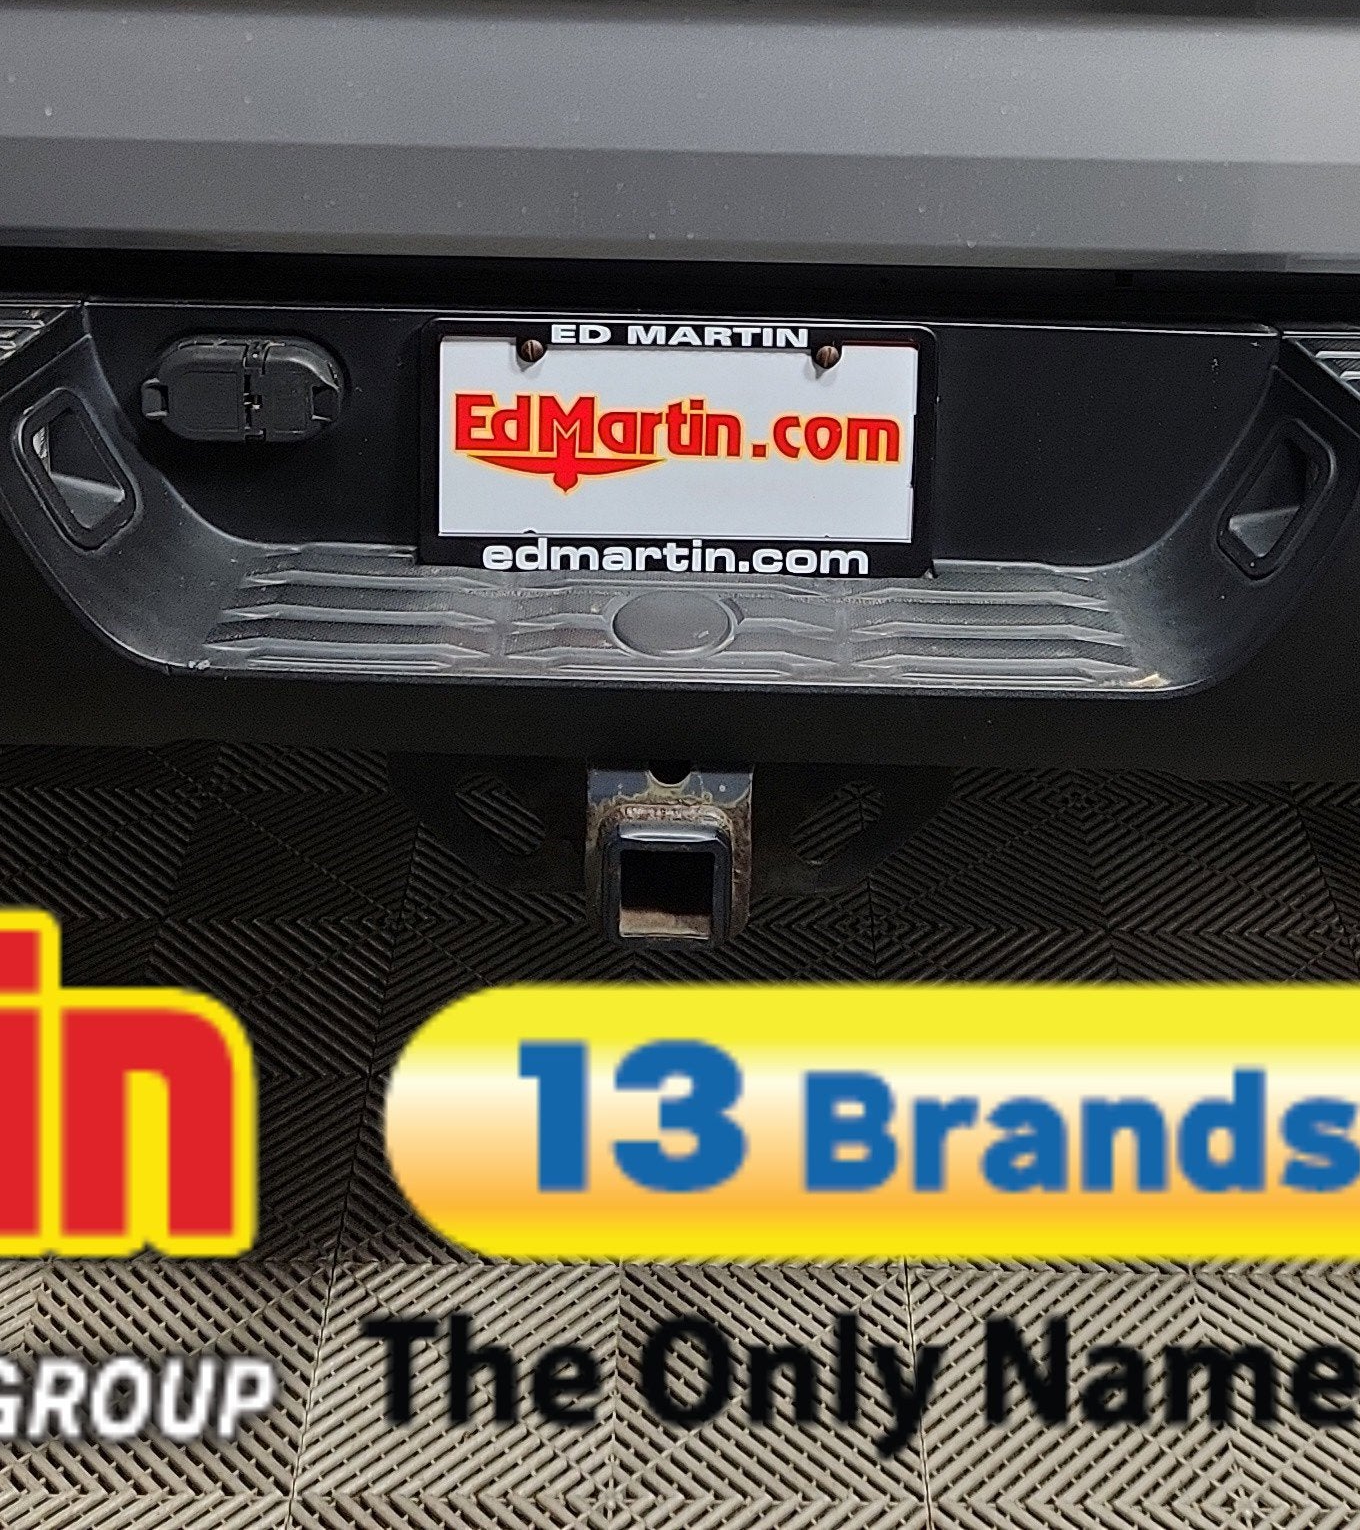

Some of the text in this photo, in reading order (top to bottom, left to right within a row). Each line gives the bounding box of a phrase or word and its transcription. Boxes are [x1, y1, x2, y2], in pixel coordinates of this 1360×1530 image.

[550, 324, 809, 348] ED MARTIN
[481, 537, 869, 575] edmartin.com
